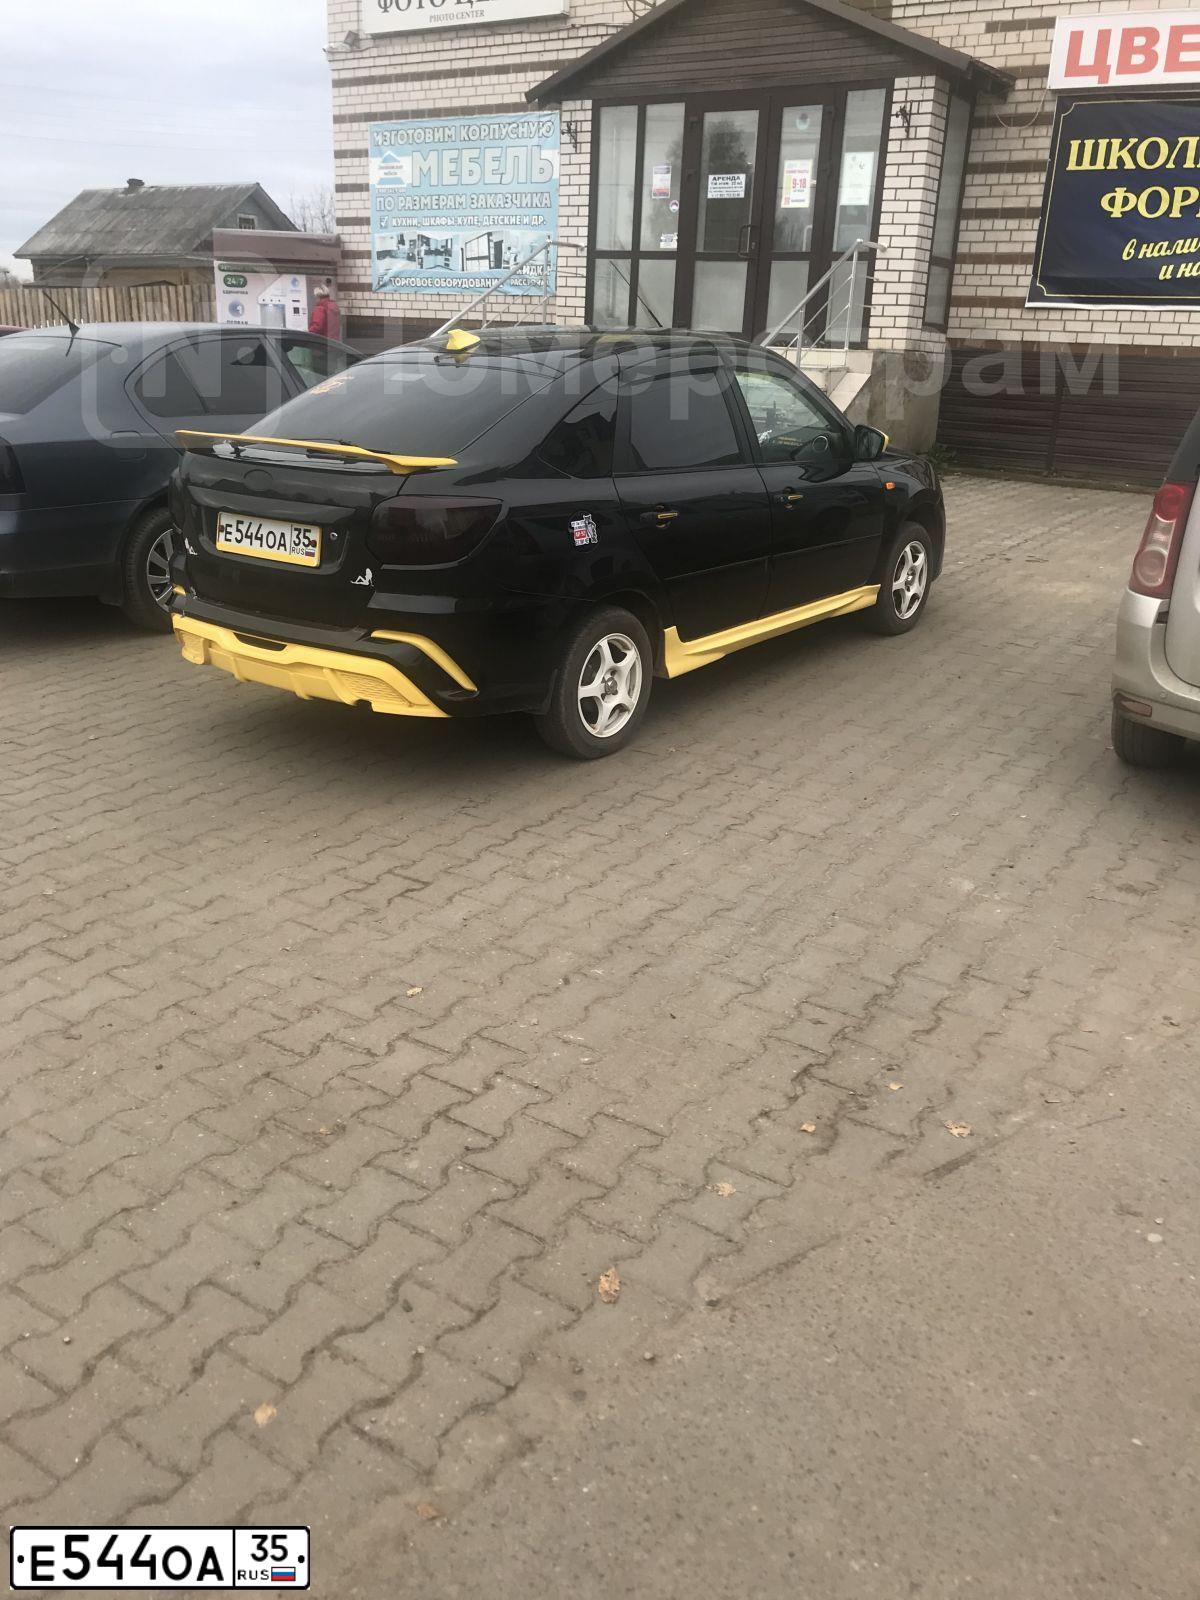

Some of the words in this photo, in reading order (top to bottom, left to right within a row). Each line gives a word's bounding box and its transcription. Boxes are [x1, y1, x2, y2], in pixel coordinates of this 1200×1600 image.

[429, 13, 455, 23] PHOTO
[456, 9, 485, 20] CENTER
[1064, 24, 1200, 84] ЦВЕ
[373, 124, 456, 147] ИЗГОТОВИМ
[459, 120, 556, 142] КОРПУСНУЮ
[1066, 136, 1200, 171] ШКОЛ
[411, 145, 554, 188] МЕБЕЛЬ
[376, 195, 395, 212] ПО
[398, 194, 466, 211] РАЗМЕРАМ
[469, 192, 552, 210] ЗАКАЗЧИКА
[1100, 186, 1200, 218] ФОР
[483, 214, 520, 226] ДЕТСКИЕ
[523, 214, 530, 226] И
[531, 214, 546, 227] ДР.
[1122, 239, 1137, 260] в
[1159, 264, 1174, 280] и
[391, 277, 433, 288] ТОРГОВОЕ
[434, 278, 503, 290] ОБОРУДОВАНИ
[224, 520, 288, 552] Е544ОА
[292, 527, 312, 549] 35
[291, 547, 305, 556] RUS
